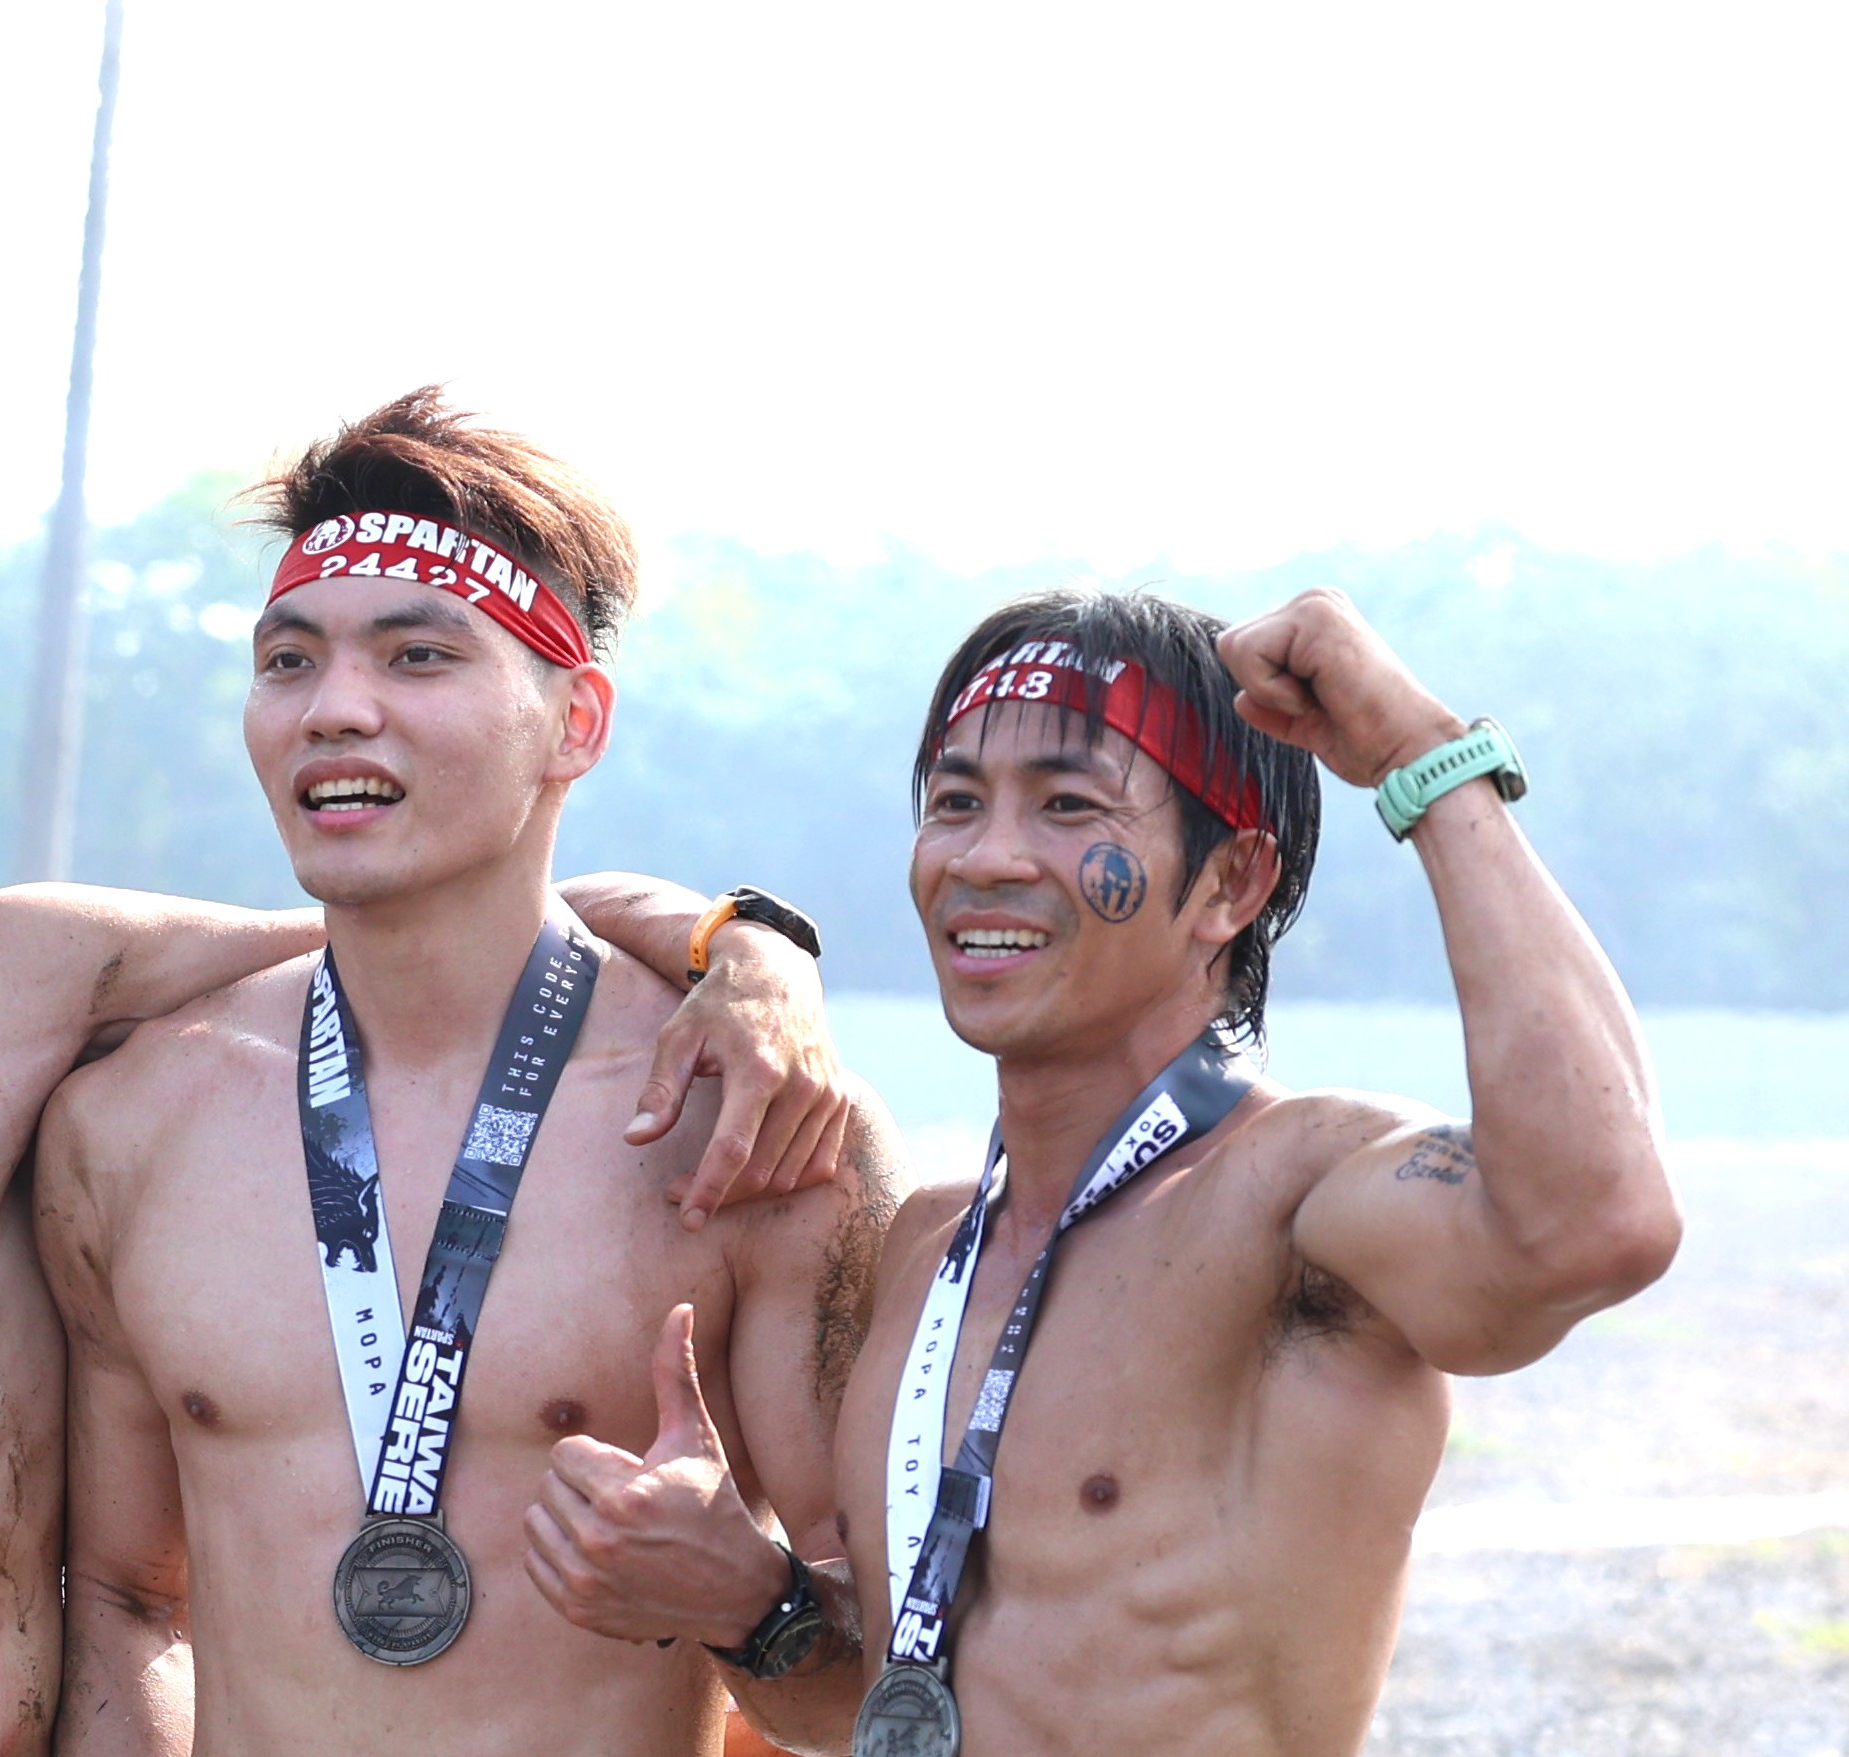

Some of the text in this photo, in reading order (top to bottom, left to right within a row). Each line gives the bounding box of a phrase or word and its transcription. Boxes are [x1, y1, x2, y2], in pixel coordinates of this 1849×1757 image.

[355, 512, 537, 613] SPARTAN
[308, 968, 351, 1108] SPARTAN
[502, 1035, 534, 1093] THIS
[533, 957, 563, 1014] CODE
[519, 1056, 546, 1098] FOR
[368, 1536, 435, 1555] FINISHER
